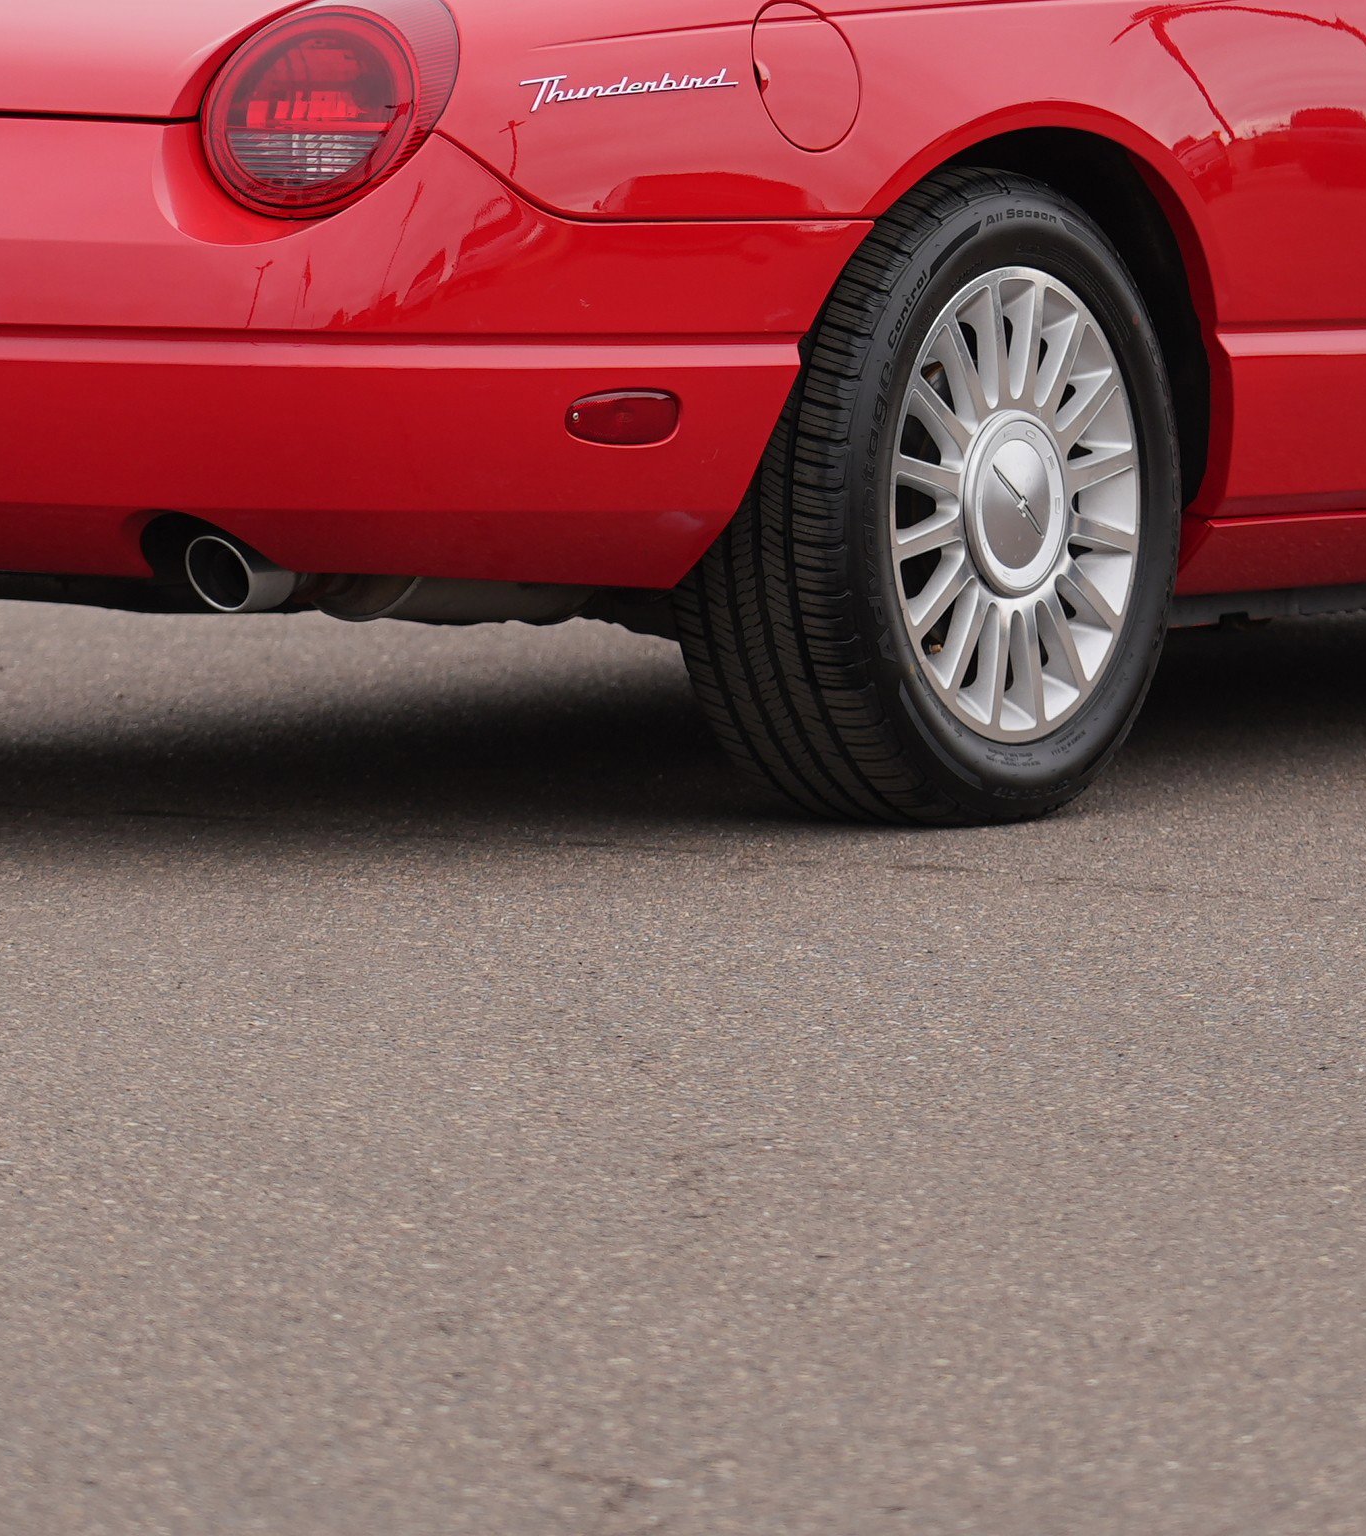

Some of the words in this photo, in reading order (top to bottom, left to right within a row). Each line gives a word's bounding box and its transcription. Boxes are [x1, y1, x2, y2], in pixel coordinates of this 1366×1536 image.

[519, 67, 739, 114] Thunderbird
[985, 211, 1004, 227] All
[886, 270, 929, 352] Control
